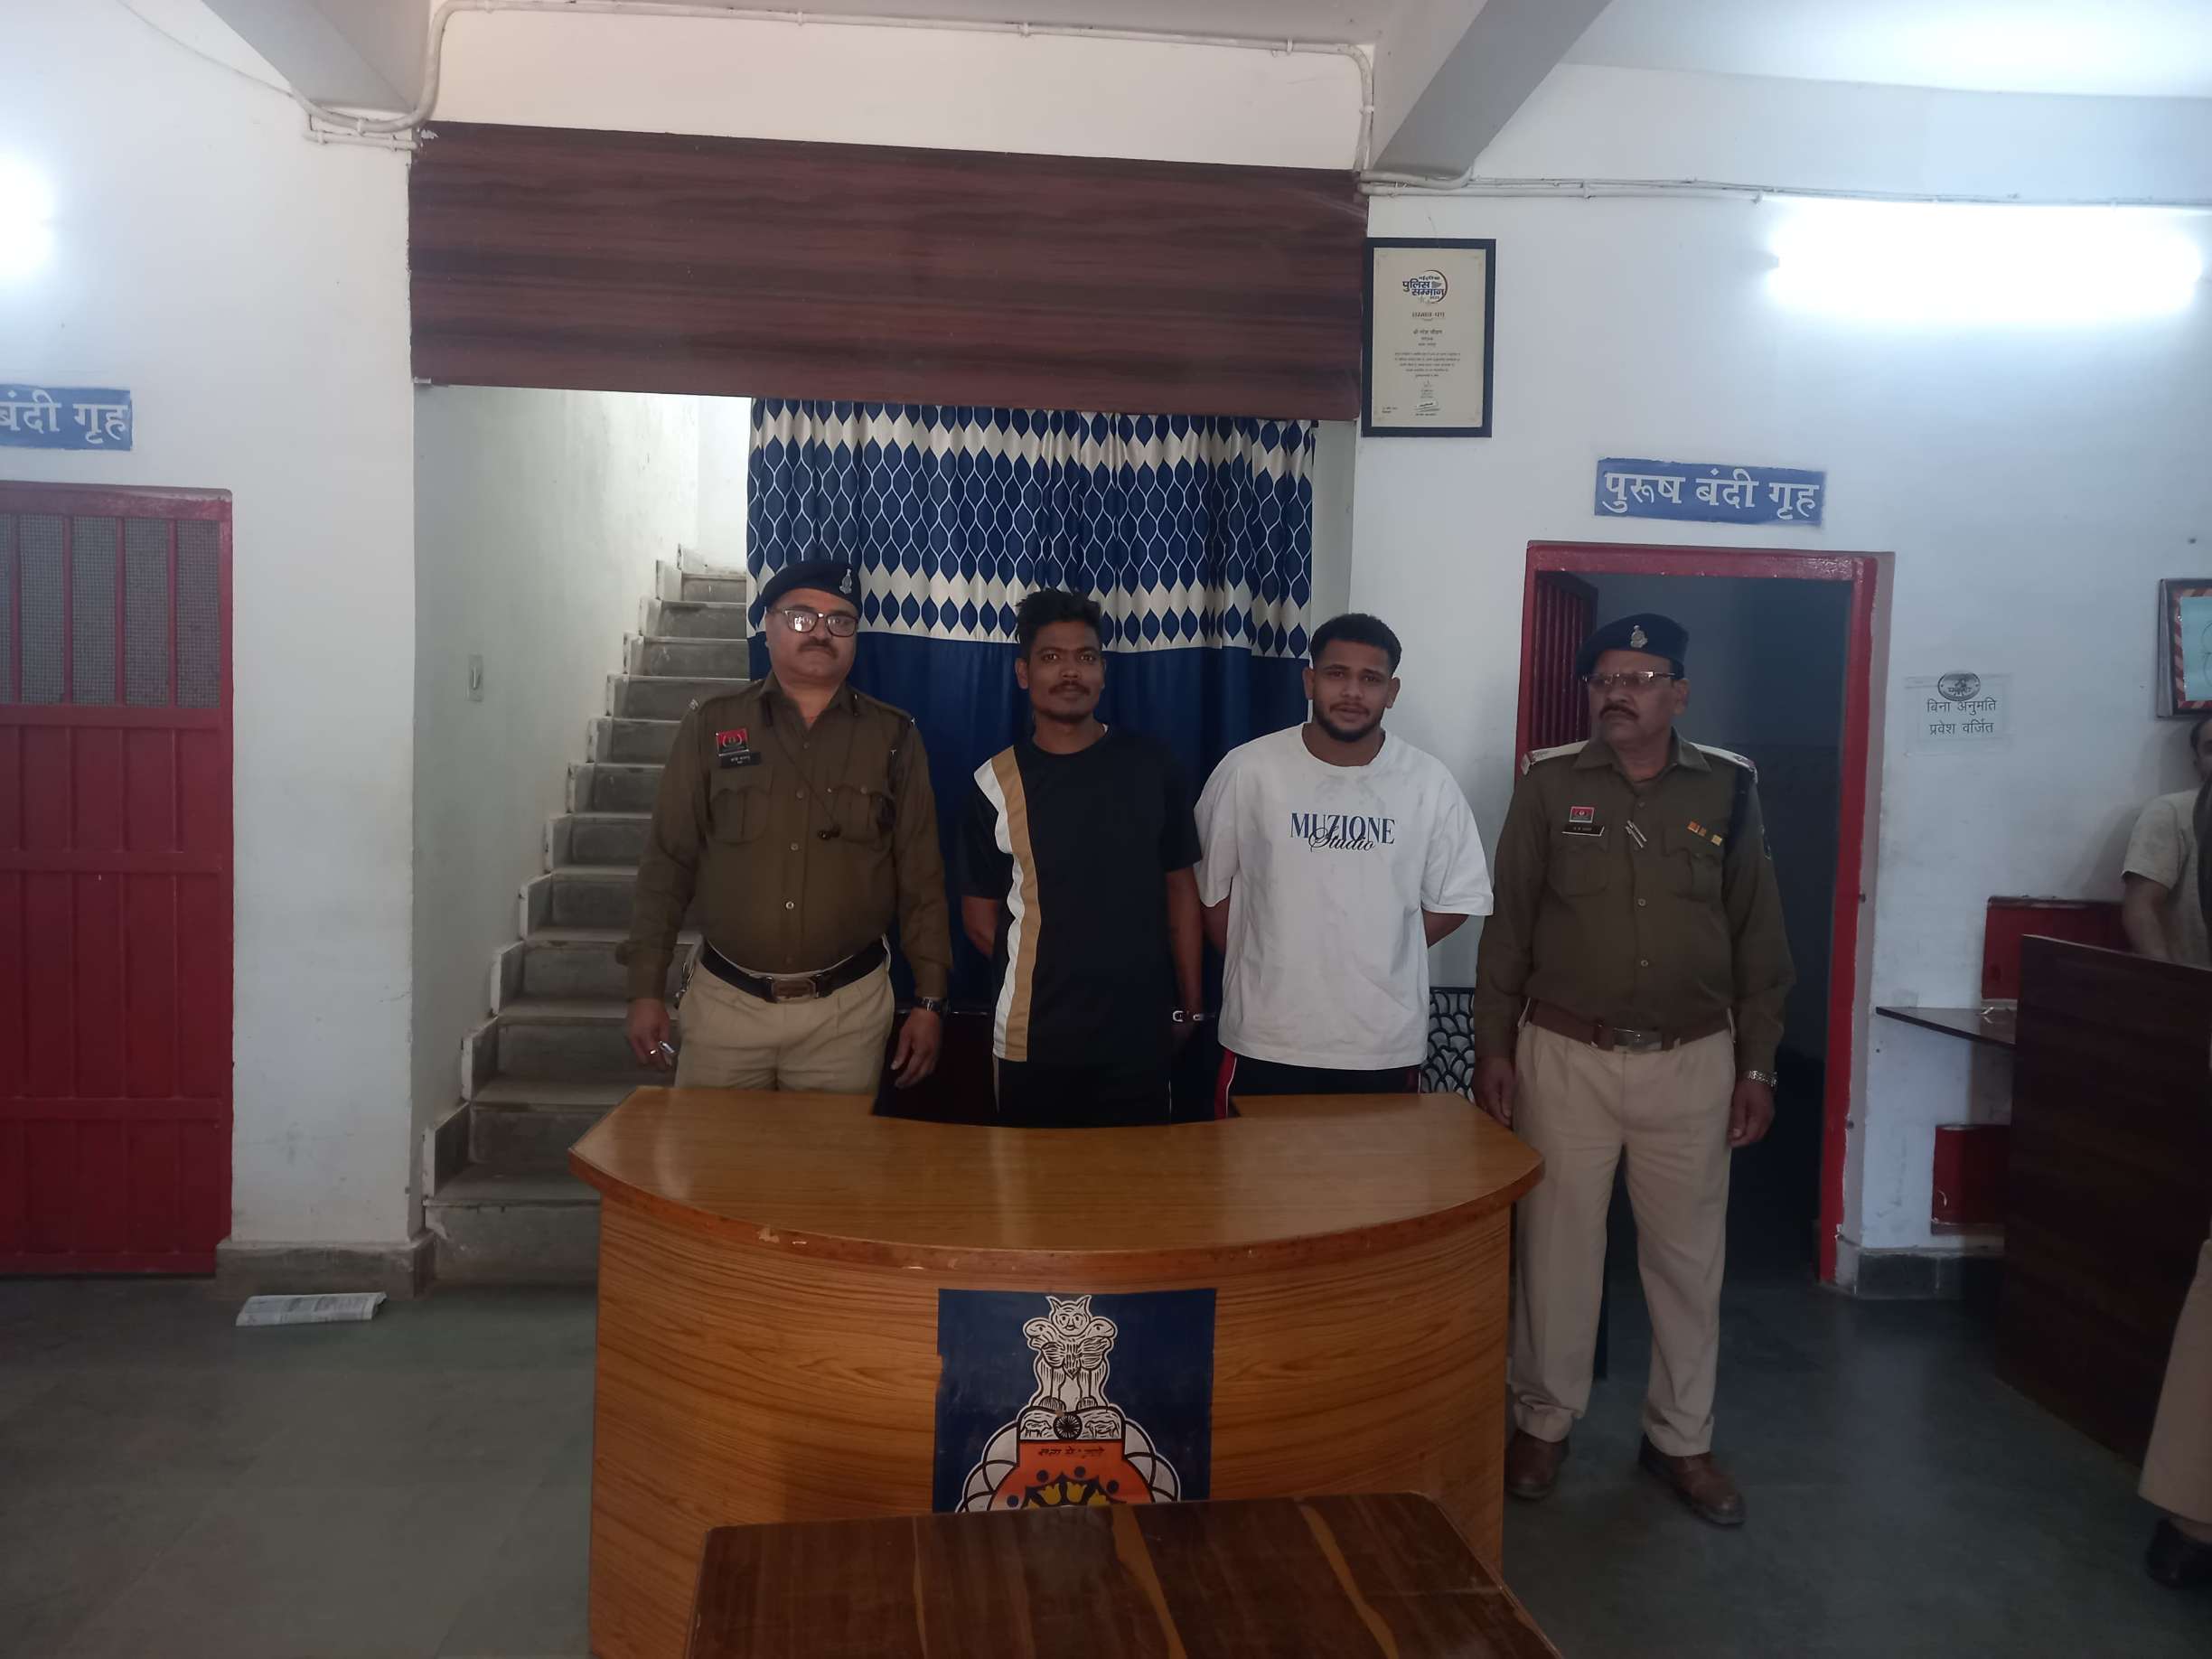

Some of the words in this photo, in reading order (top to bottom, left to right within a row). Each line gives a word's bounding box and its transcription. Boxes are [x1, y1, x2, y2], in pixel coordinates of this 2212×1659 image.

[1402, 277, 1430, 292] पुलिस
[1411, 288, 1445, 296] सम्मान
[0, 389, 61, 434] बंदी
[72, 403, 128, 444] गृह
[1695, 468, 1759, 509] बंदी
[1768, 482, 1820, 520] गृह
[1926, 698, 1951, 713] बिना
[1957, 697, 1997, 716] अनुमति
[1929, 720, 1955, 736] प्रवेश
[1962, 718, 1994, 734] वर्जित
[1290, 812, 1395, 844] MUZIONE
[1308, 826, 1374, 852] Studio
